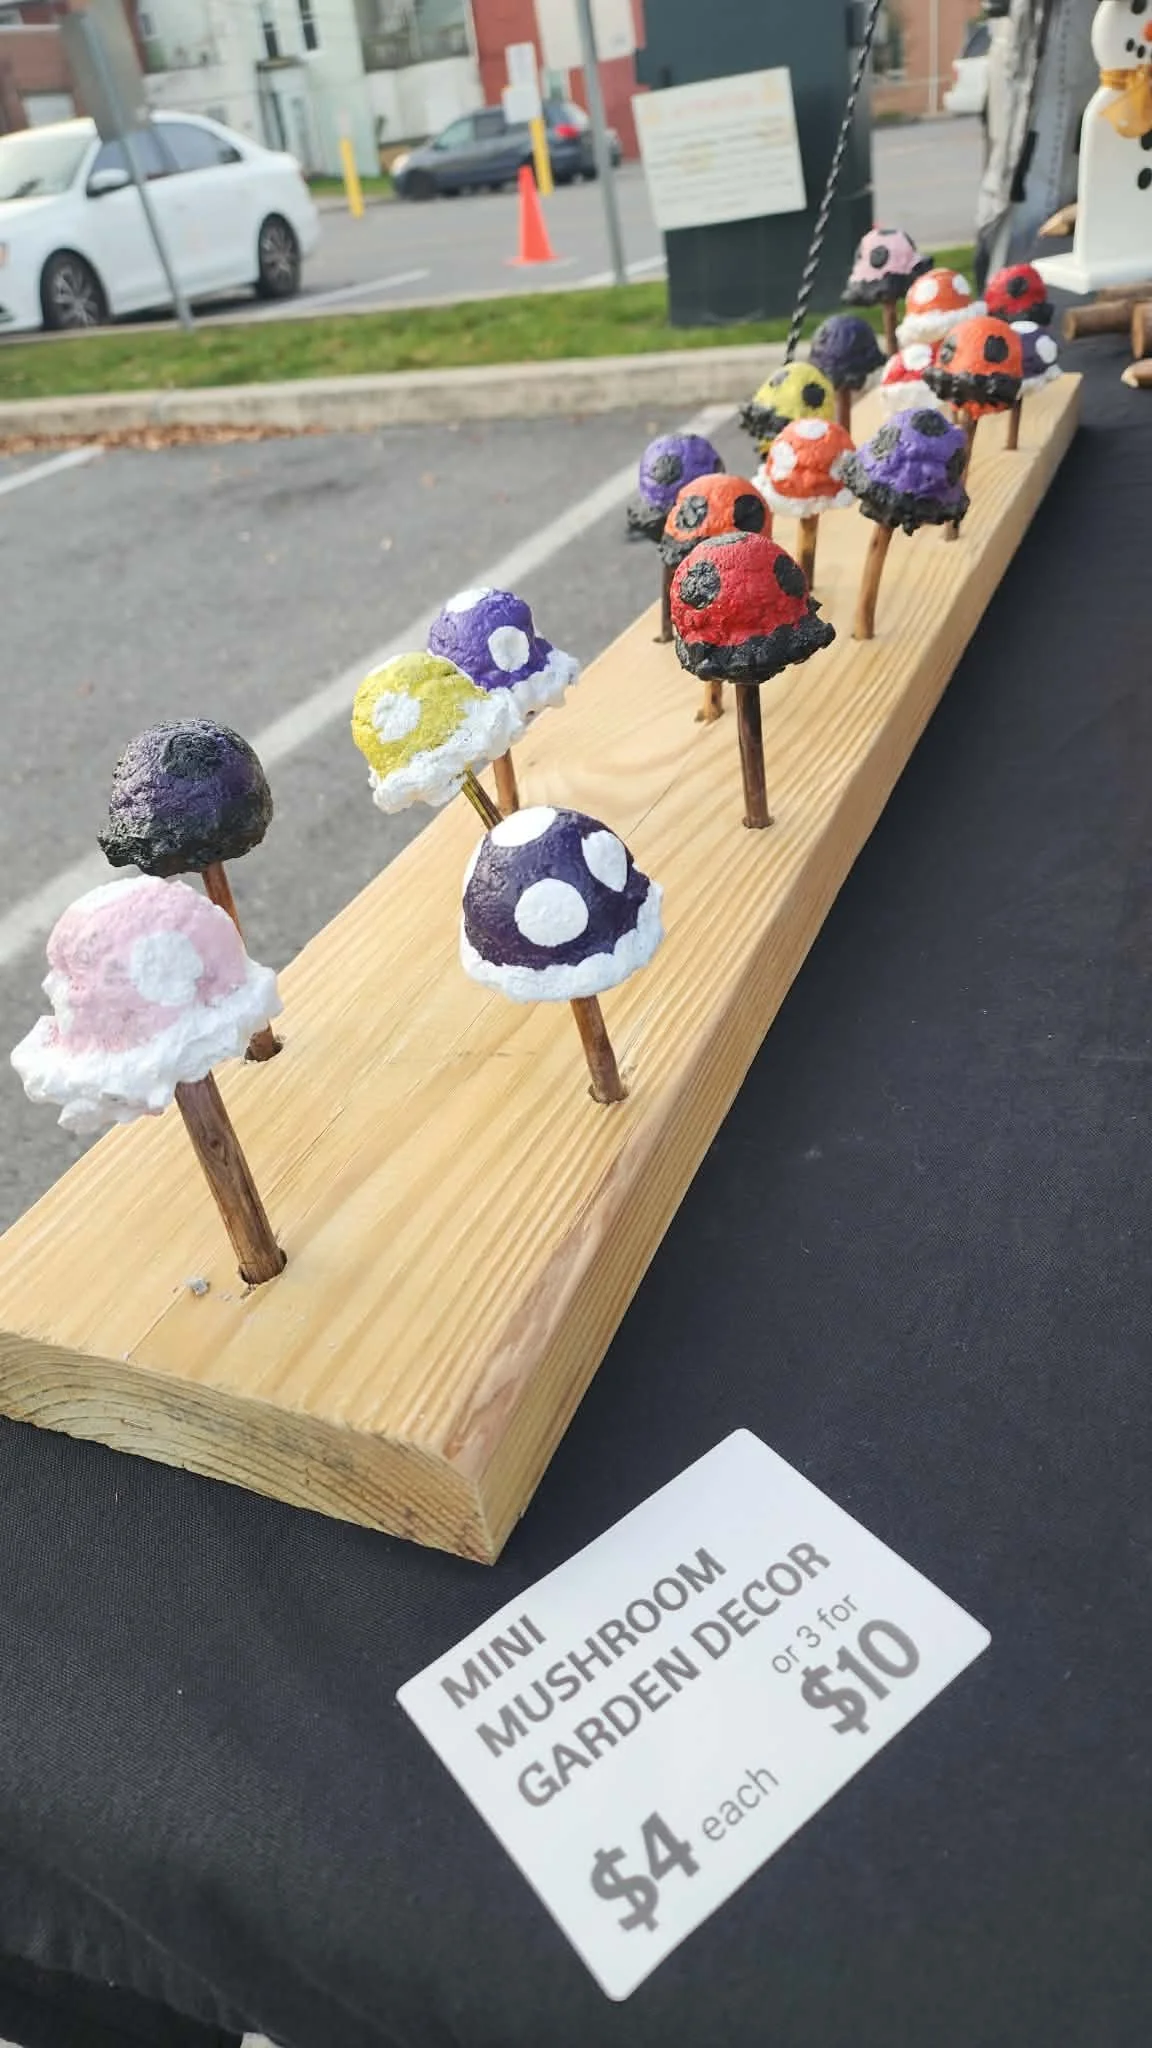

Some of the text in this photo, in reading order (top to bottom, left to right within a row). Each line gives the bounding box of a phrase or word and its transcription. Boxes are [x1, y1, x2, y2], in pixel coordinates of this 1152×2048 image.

[439, 1613, 547, 1710] MINI
[475, 1547, 727, 1759] MUSHROOM
[517, 1542, 831, 1808] GARDEN DECOR
[771, 1593, 860, 1675] or 3 for
[800, 1619, 920, 1735] $10
[589, 1764, 780, 1933] $4 each
